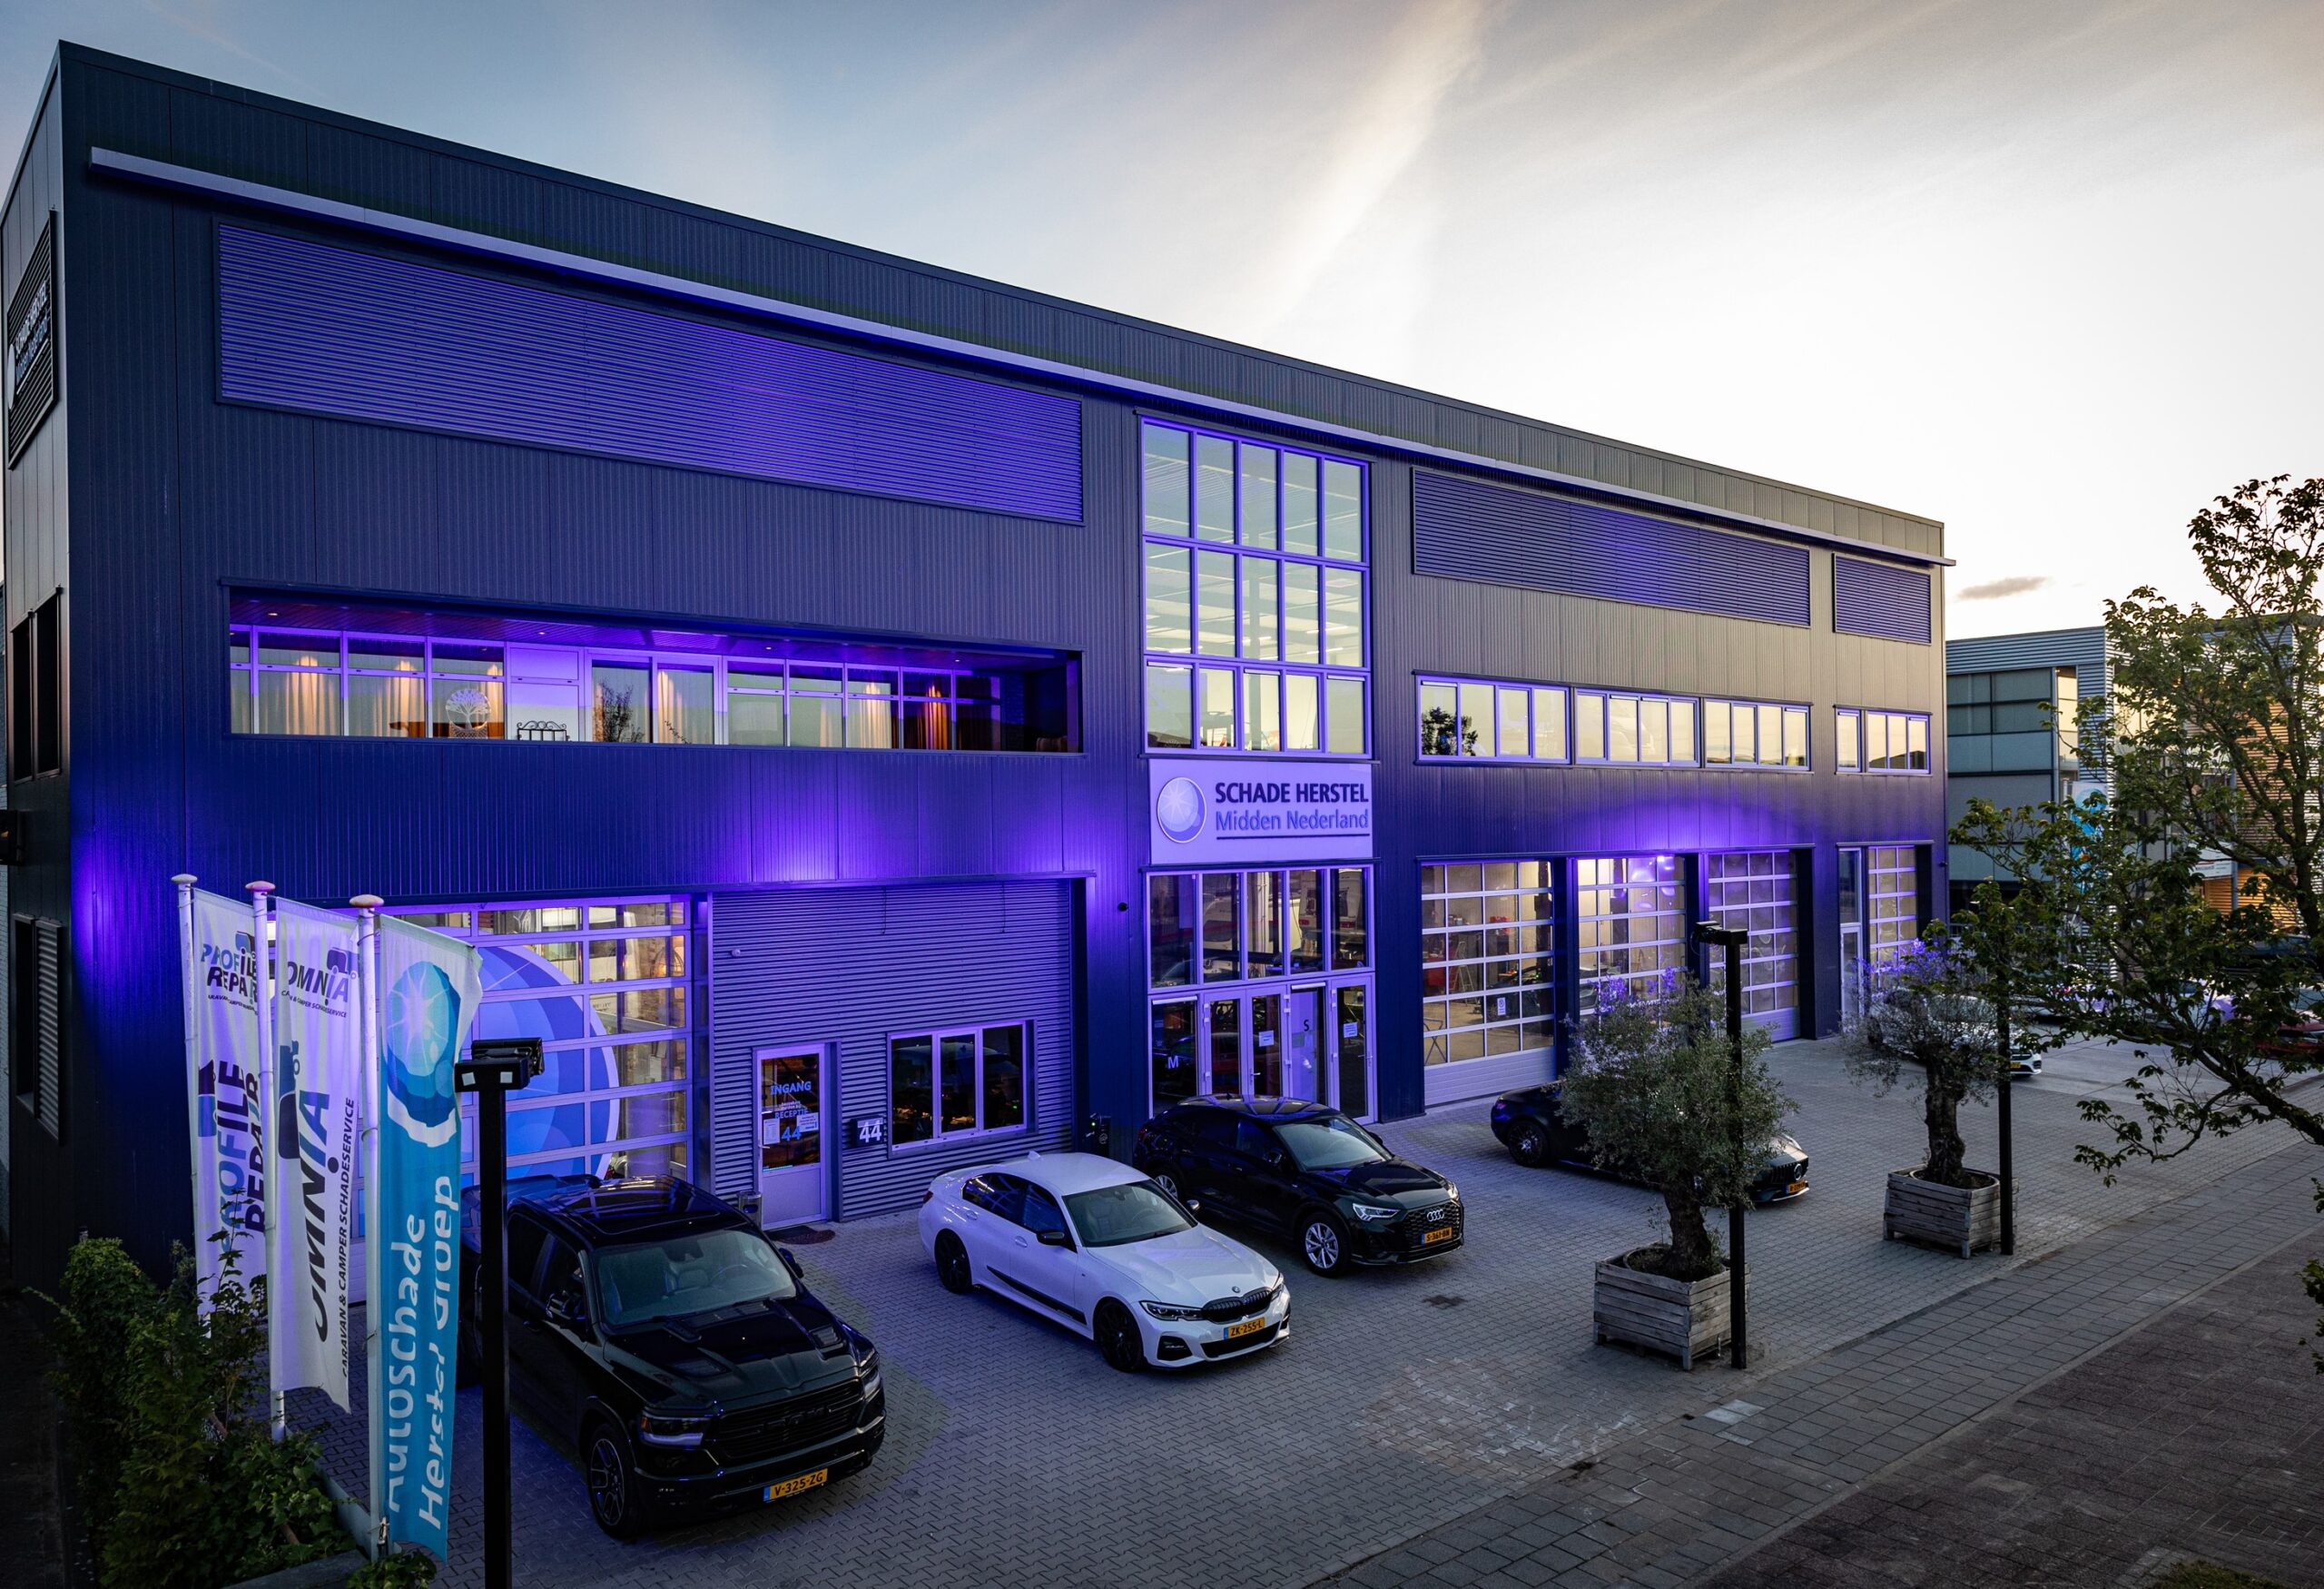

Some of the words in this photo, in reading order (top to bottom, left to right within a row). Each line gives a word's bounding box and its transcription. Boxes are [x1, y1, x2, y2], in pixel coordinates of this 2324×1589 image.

[1216, 782, 1290, 804] SCHADE
[1296, 783, 1369, 803] HERSTEL
[1216, 809, 1281, 831] Midden
[1286, 808, 1369, 830] Nederland
[770, 1081, 812, 1096] INGANG
[775, 1108, 809, 1120] RECEPTIE
[782, 1126, 802, 1141] 44
[859, 1120, 882, 1143] 44
[339, 1098, 354, 1225] SCHADESERVICE
[338, 1227, 348, 1290] CAMPER
[774, 1472, 823, 1496] V-325-ZG
